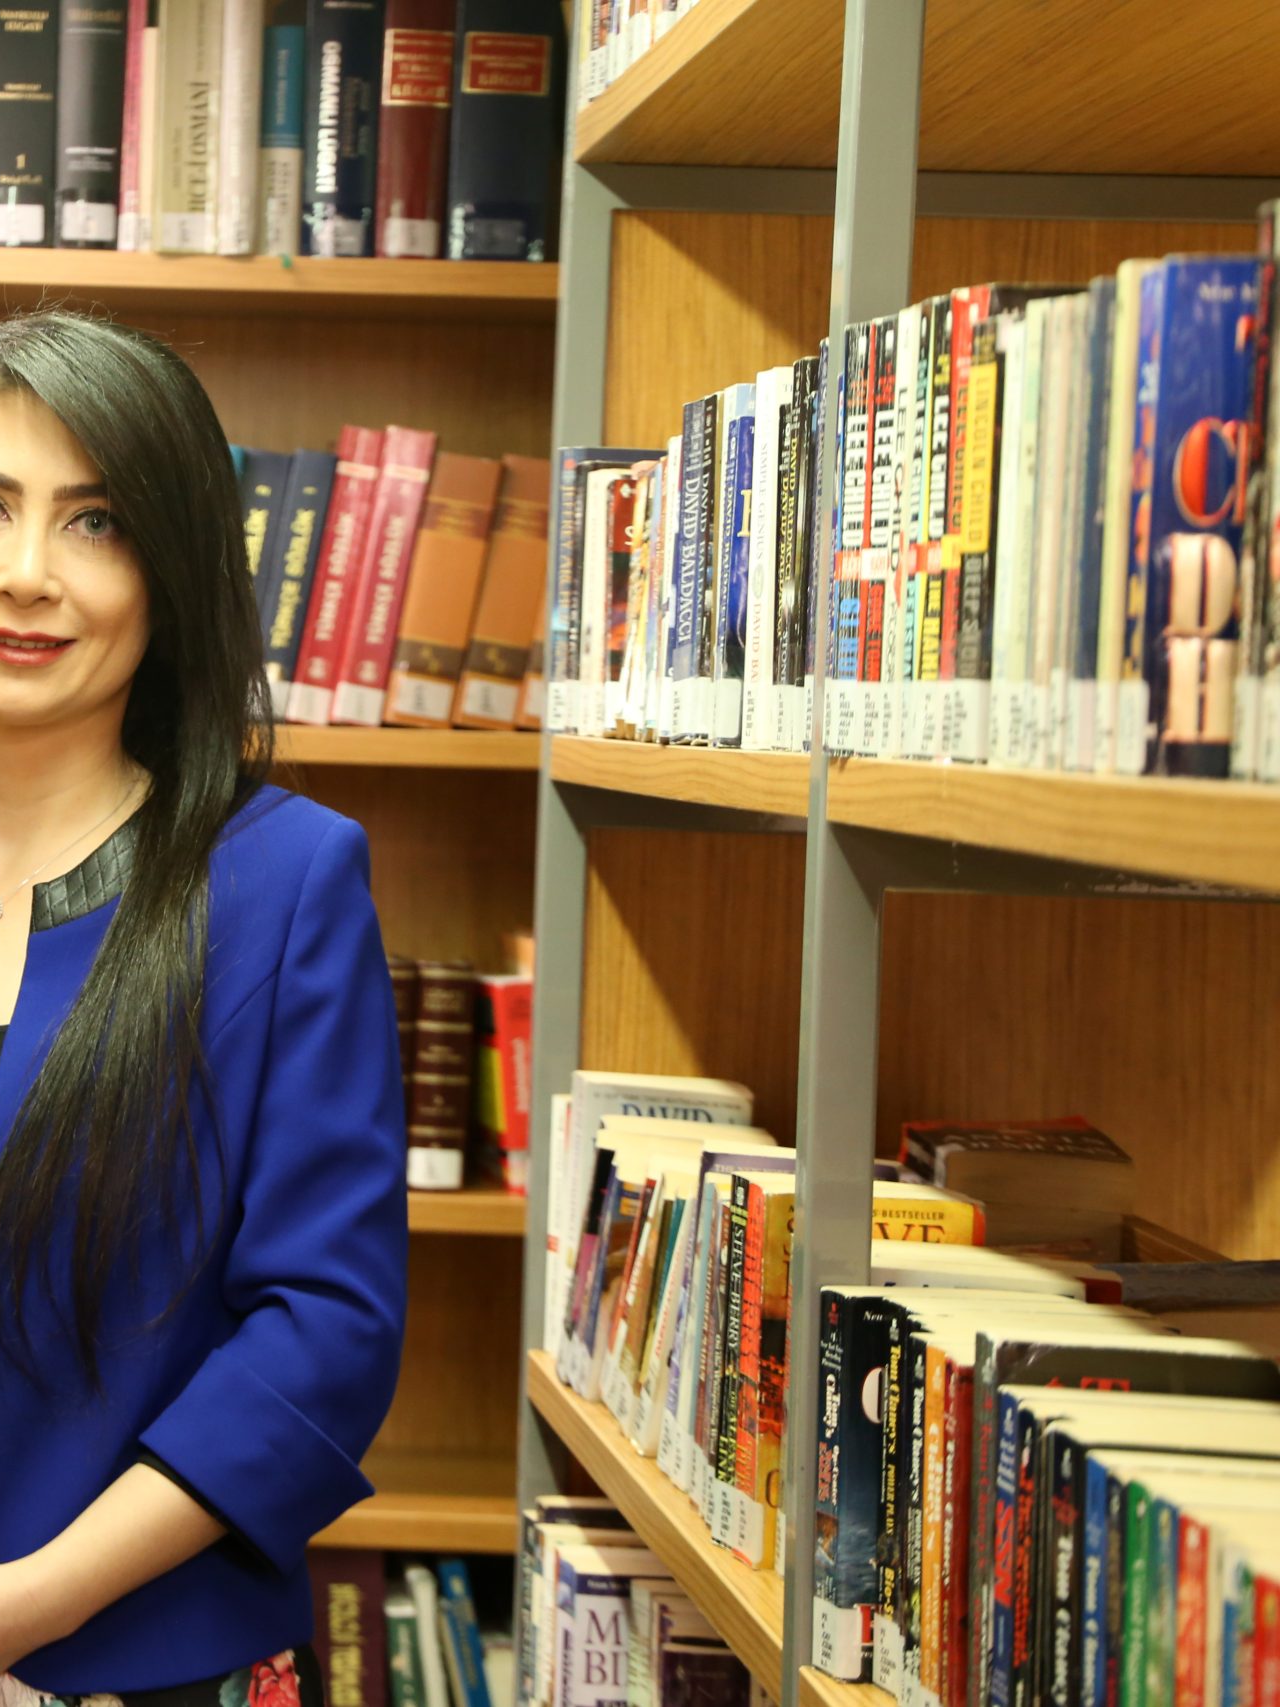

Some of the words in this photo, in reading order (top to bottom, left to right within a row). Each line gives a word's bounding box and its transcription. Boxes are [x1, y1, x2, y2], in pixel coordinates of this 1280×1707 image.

[846, 414, 868, 467] LEE
[872, 410, 894, 462] LEE
[933, 395, 949, 449] LEE
[757, 442, 768, 496] SIMPLE
[789, 437, 798, 490] DAVID
[684, 477, 701, 539] DAVID
[842, 469, 866, 548] CHILD
[870, 466, 892, 547] CHILD
[929, 454, 947, 540] CHILD
[785, 496, 794, 582] BALDACCI
[678, 544, 695, 644] BALDACCI
[902, 580, 916, 681] PERSUA
[881, 1208, 944, 1220] BESTSELLER
[731, 1226, 744, 1282] STEVE
[728, 1292, 741, 1350] BERRY
[889, 1344, 901, 1381] Tom
[822, 1373, 836, 1439] Clancy's
[885, 1383, 901, 1454] Clancy's
[912, 1386, 924, 1425] Tom
[831, 1444, 840, 1506] Op-Center
[908, 1427, 923, 1501] Clancy's
[933, 1461, 943, 1522] Tom
[945, 1438, 955, 1494] Tom
[1056, 1535, 1074, 1601] Tom
[1051, 1608, 1072, 1706] Clancy
